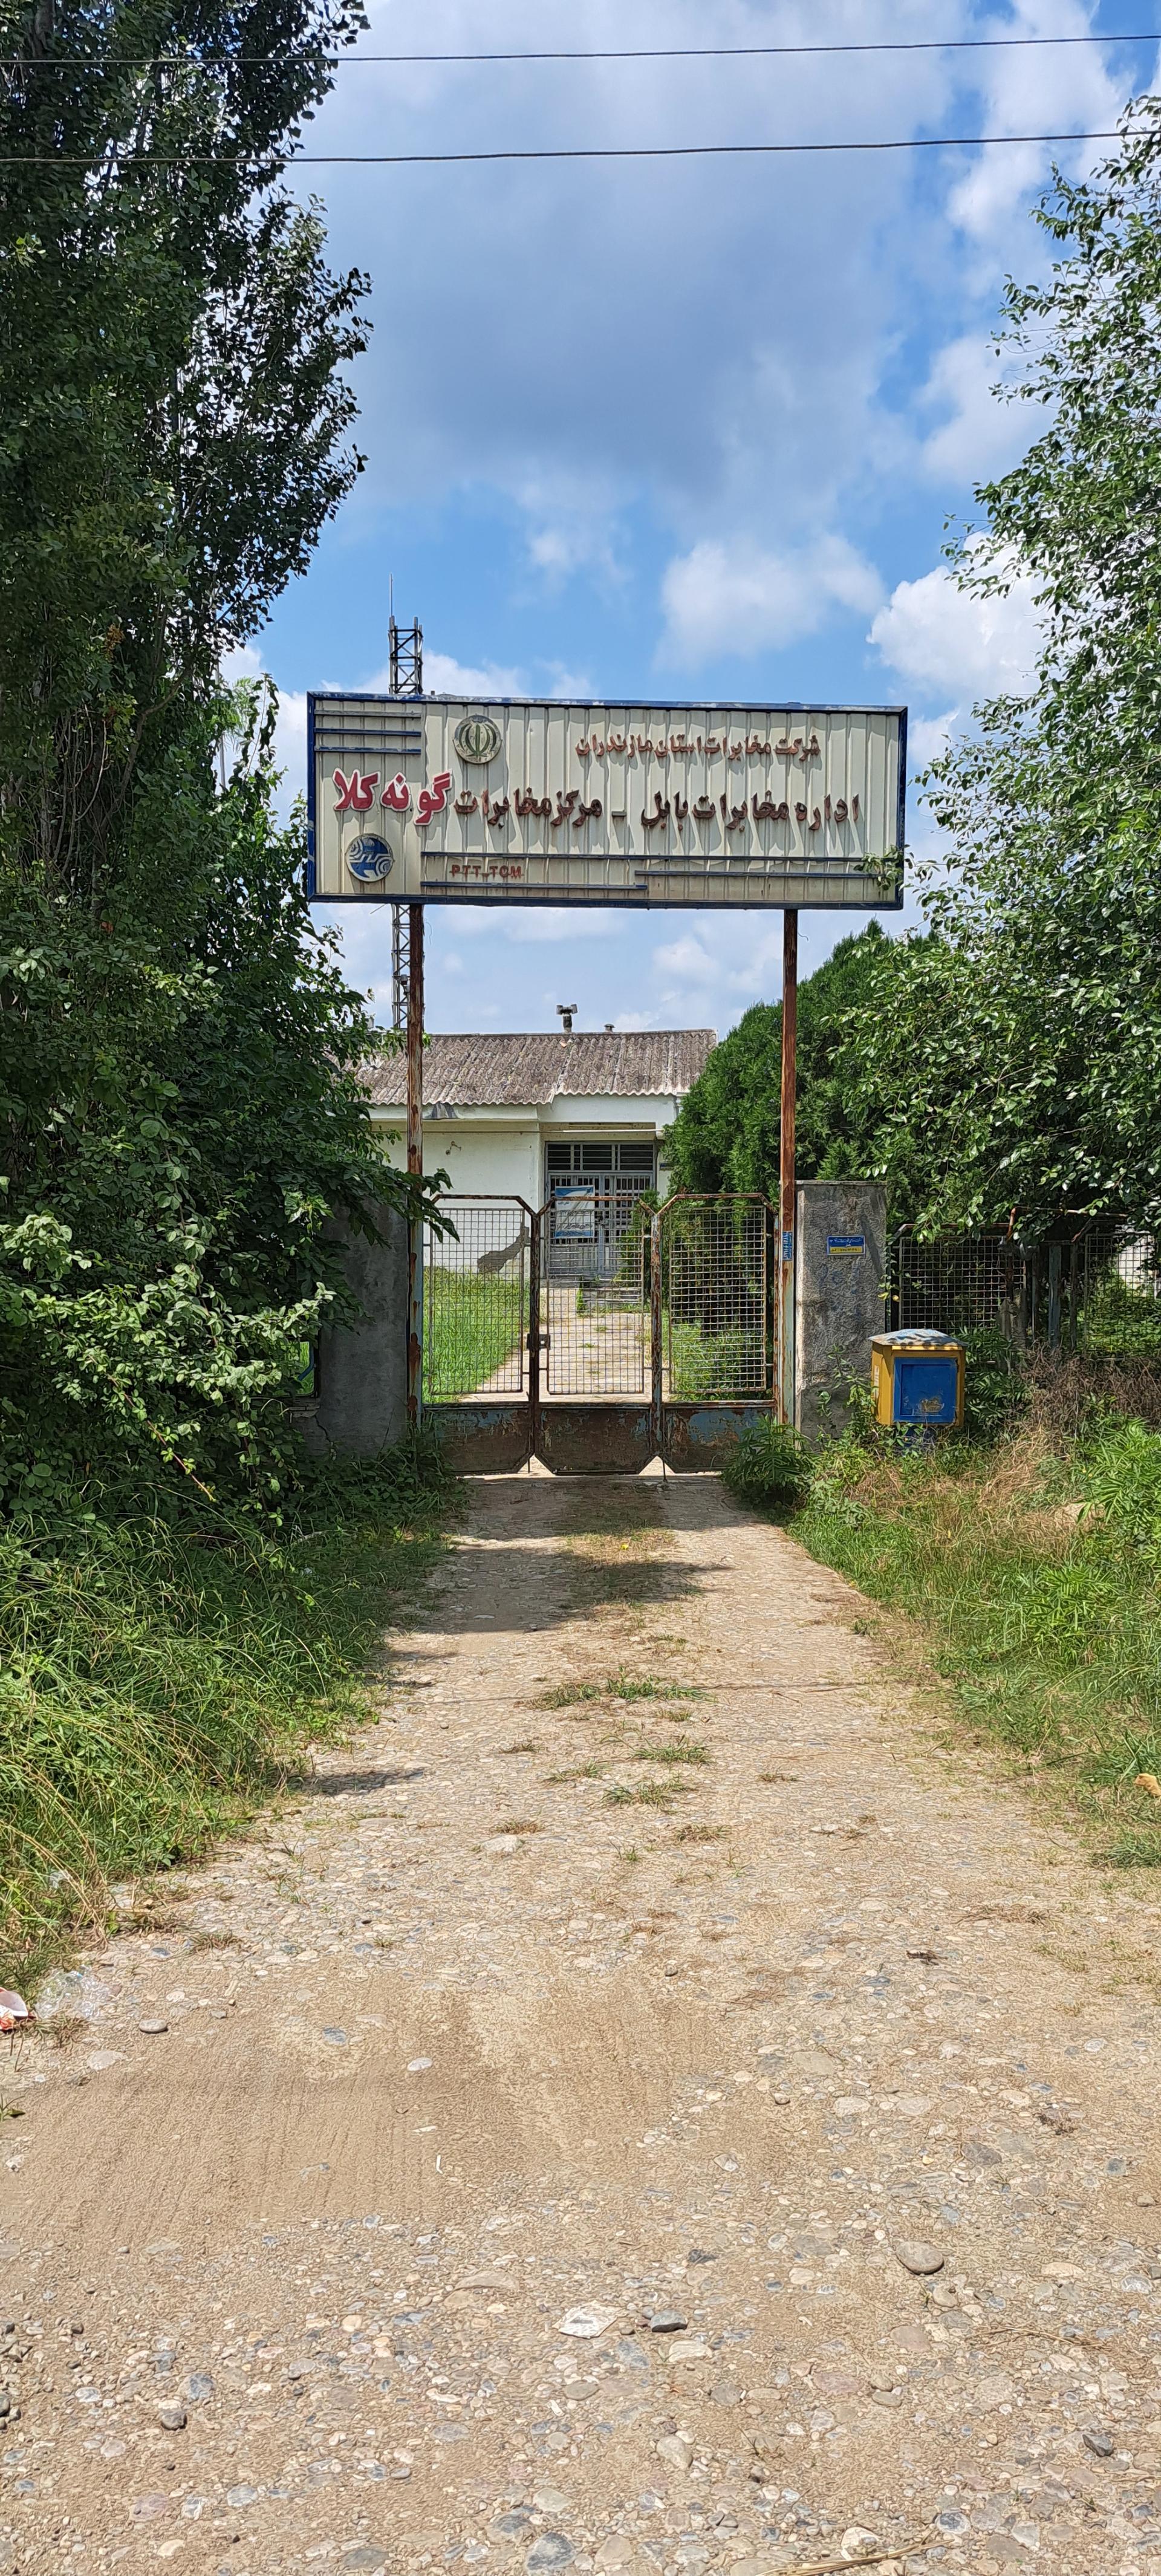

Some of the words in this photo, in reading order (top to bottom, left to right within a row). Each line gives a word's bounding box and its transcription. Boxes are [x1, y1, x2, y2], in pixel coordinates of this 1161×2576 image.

[576, 733, 654, 758] مازندران
[654, 734, 701, 757] استان
[704, 735, 772, 761] مخابرات
[775, 735, 821, 761] شرکت
[454, 787, 552, 828] مخابرات
[550, 789, 602, 827] مرکز
[641, 791, 688, 831] بابل
[692, 790, 789, 832] مخابرات
[794, 793, 859, 831] اداره
